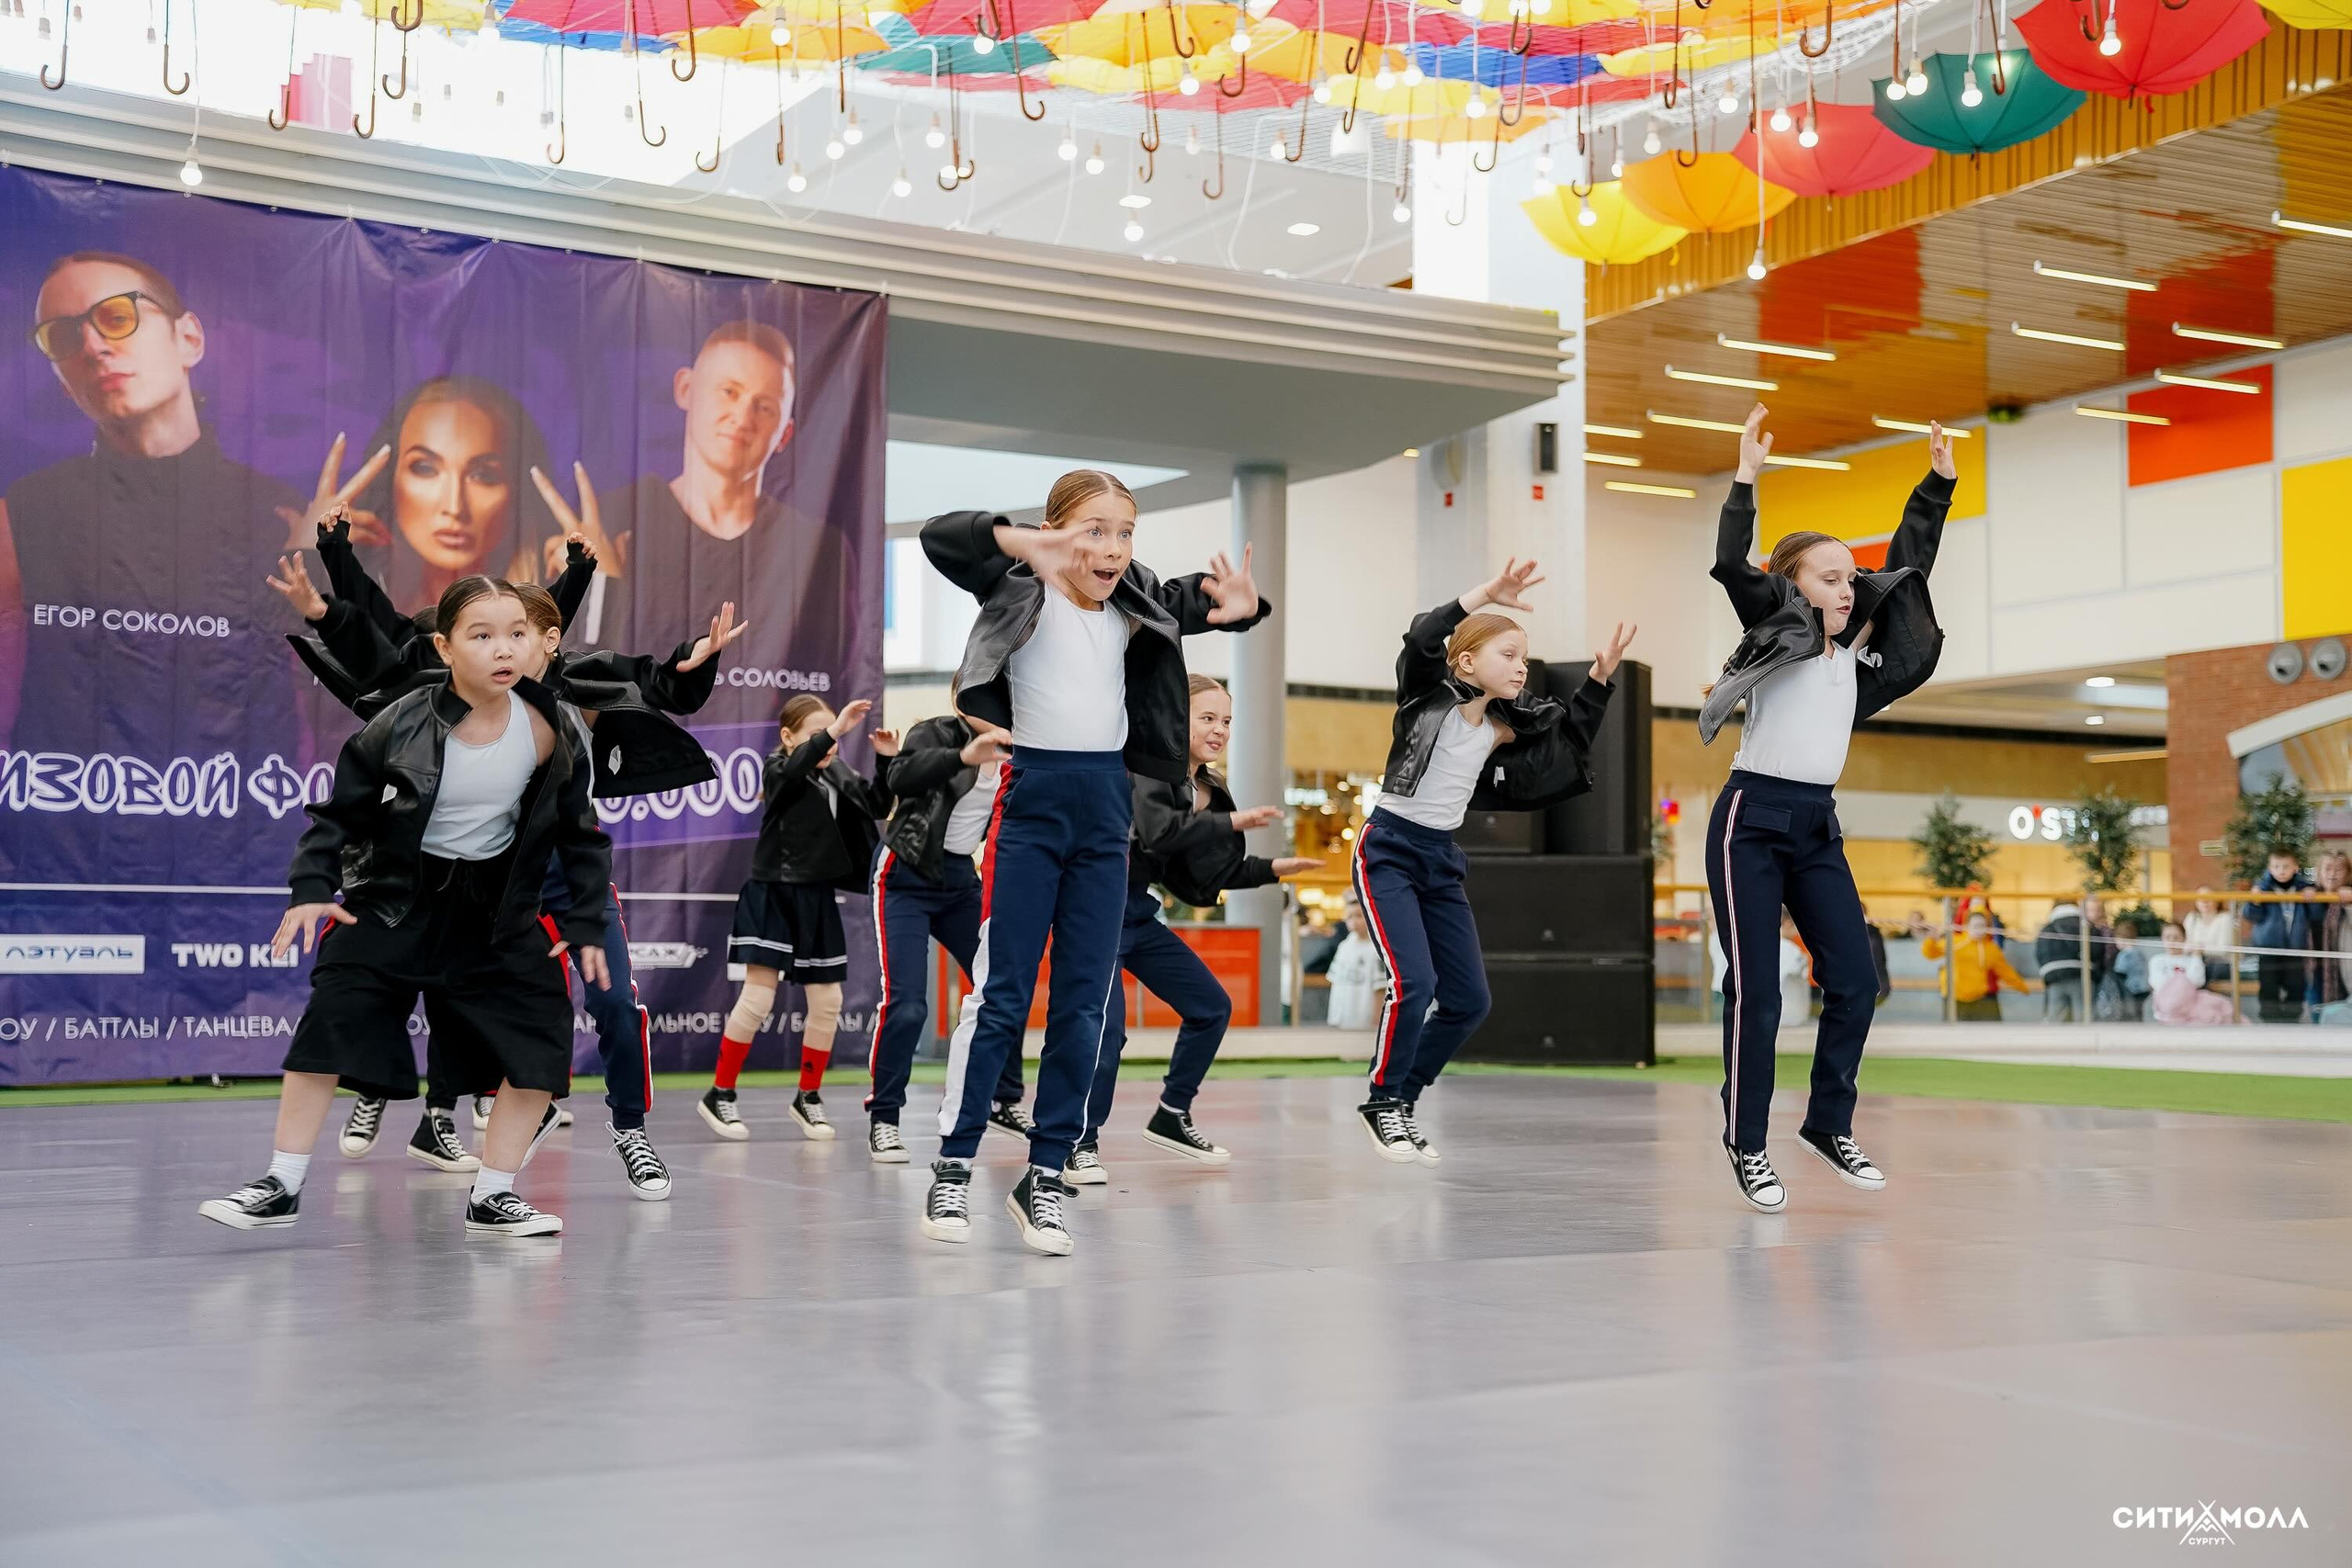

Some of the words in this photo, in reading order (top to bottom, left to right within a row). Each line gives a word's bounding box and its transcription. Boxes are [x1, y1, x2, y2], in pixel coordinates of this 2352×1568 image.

[34, 604, 96, 628] ЕГОР
[102, 608, 231, 637] СОКОЛОВ
[728, 666, 831, 692] СОЛОВЬЕВ
[246, 753, 335, 820] ФО
[171, 942, 244, 967] TWO
[65, 1016, 159, 1040] БАТТЛЫ
